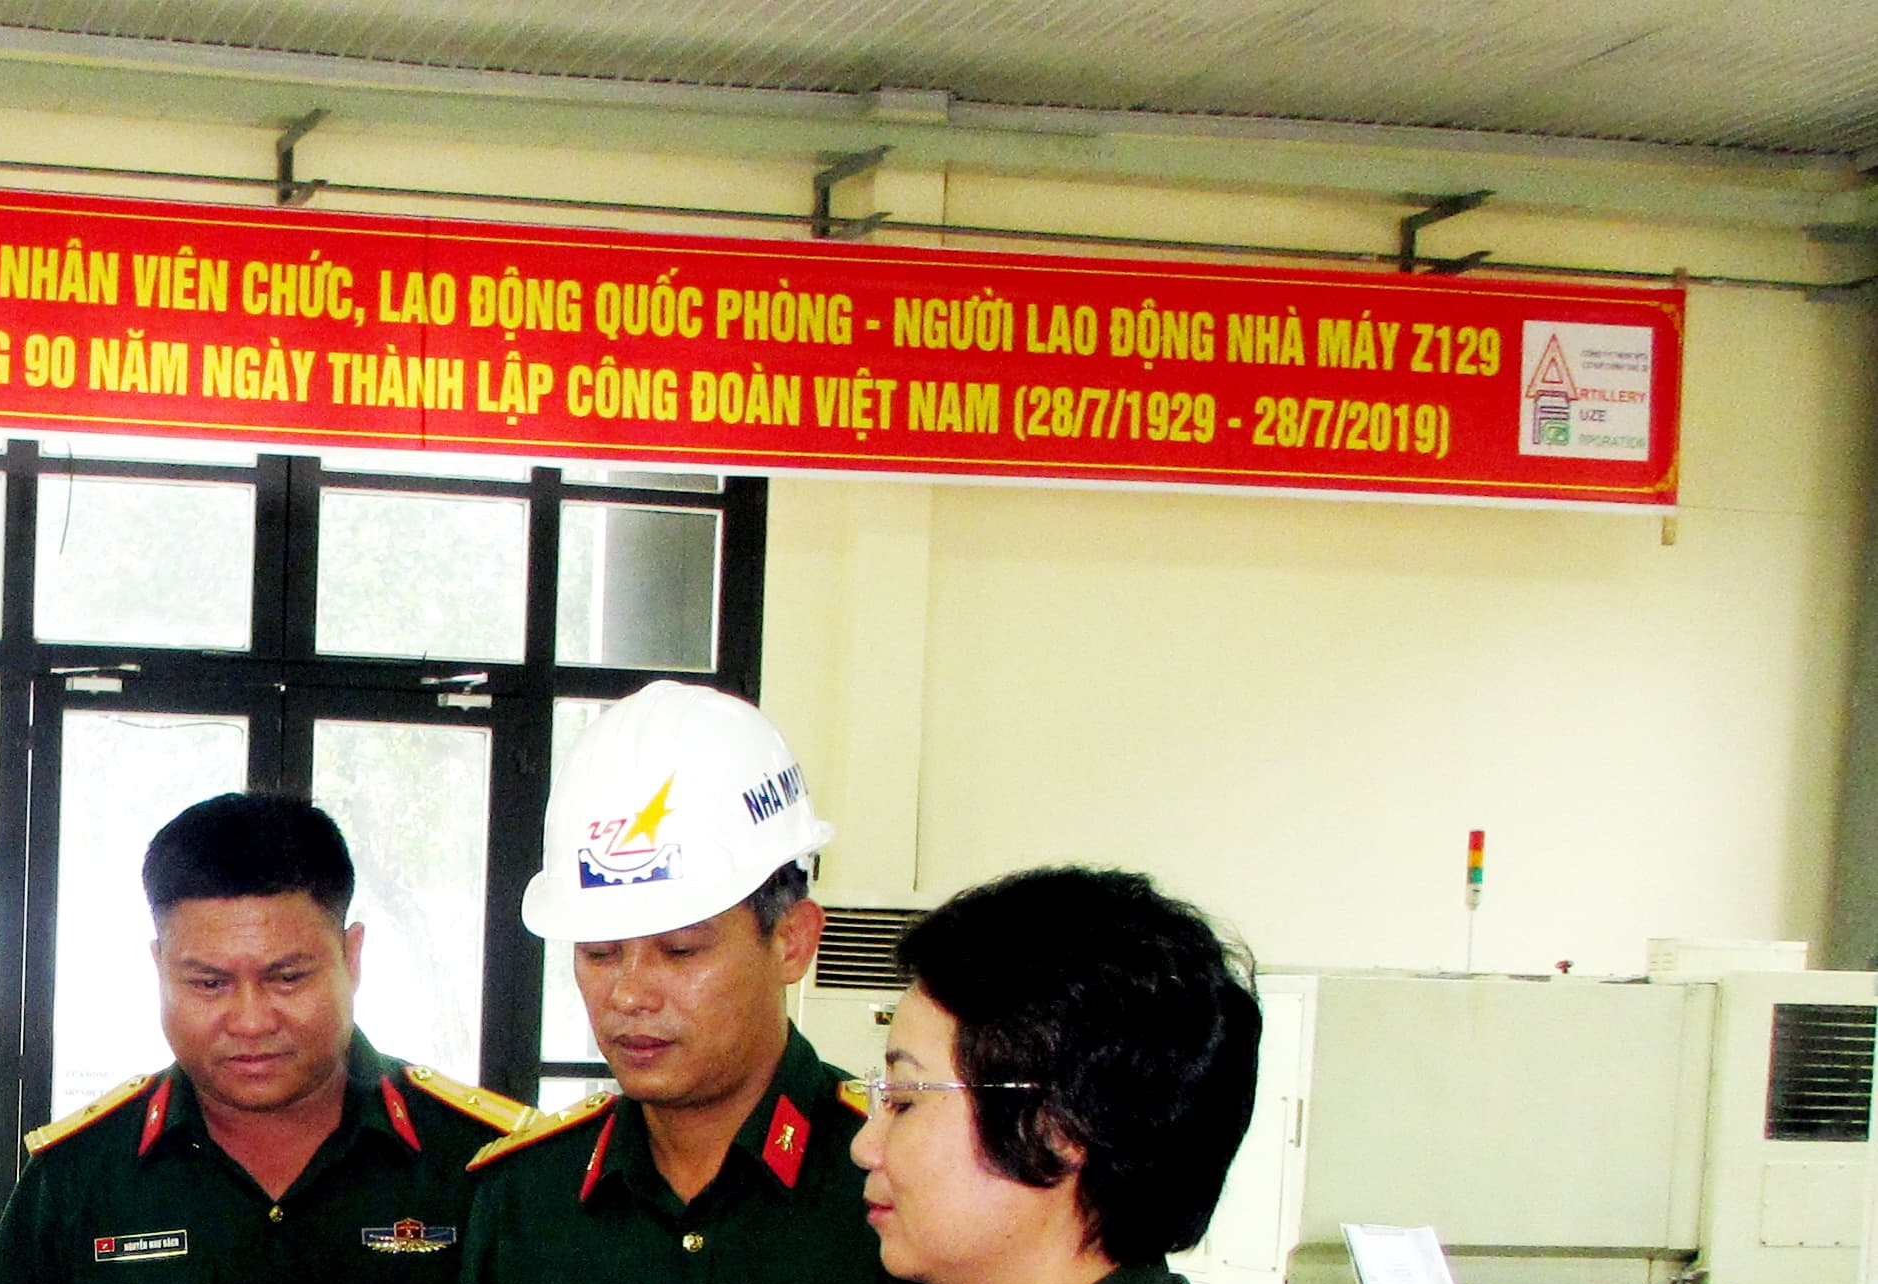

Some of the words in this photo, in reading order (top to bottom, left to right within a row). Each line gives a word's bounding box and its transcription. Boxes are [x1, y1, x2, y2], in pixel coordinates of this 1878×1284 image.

[131, 244, 230, 313] VIÊN
[241, 249, 367, 328] CHỨC,
[378, 269, 457, 327] LAO
[467, 265, 583, 342] ĐỘNG
[594, 267, 704, 341] QUỐC
[715, 278, 853, 345] PHÒNG
[893, 287, 1015, 352] NGƯỜI
[1026, 303, 1098, 356] LAO
[1109, 298, 1215, 370] ĐỘNG
[1226, 305, 1306, 366] NHÀ
[1317, 309, 1401, 371] MÁY
[1410, 323, 1501, 377] Z129
[22, 332, 79, 390] 90
[85, 327, 192, 398] NĂM
[197, 335, 317, 404] NGÀY
[325, 343, 468, 413] THÀNH
[475, 349, 556, 427] LẬP
[565, 354, 679, 422] CÔNG
[688, 361, 802, 427] ĐOÀN
[813, 367, 898, 441] VIỆT
[907, 380, 1001, 435] NAM
[1013, 385, 1216, 444] (28/7/1929
[1252, 395, 1450, 460] 28/7/2019)
[742, 772, 784, 825] NHÀ
